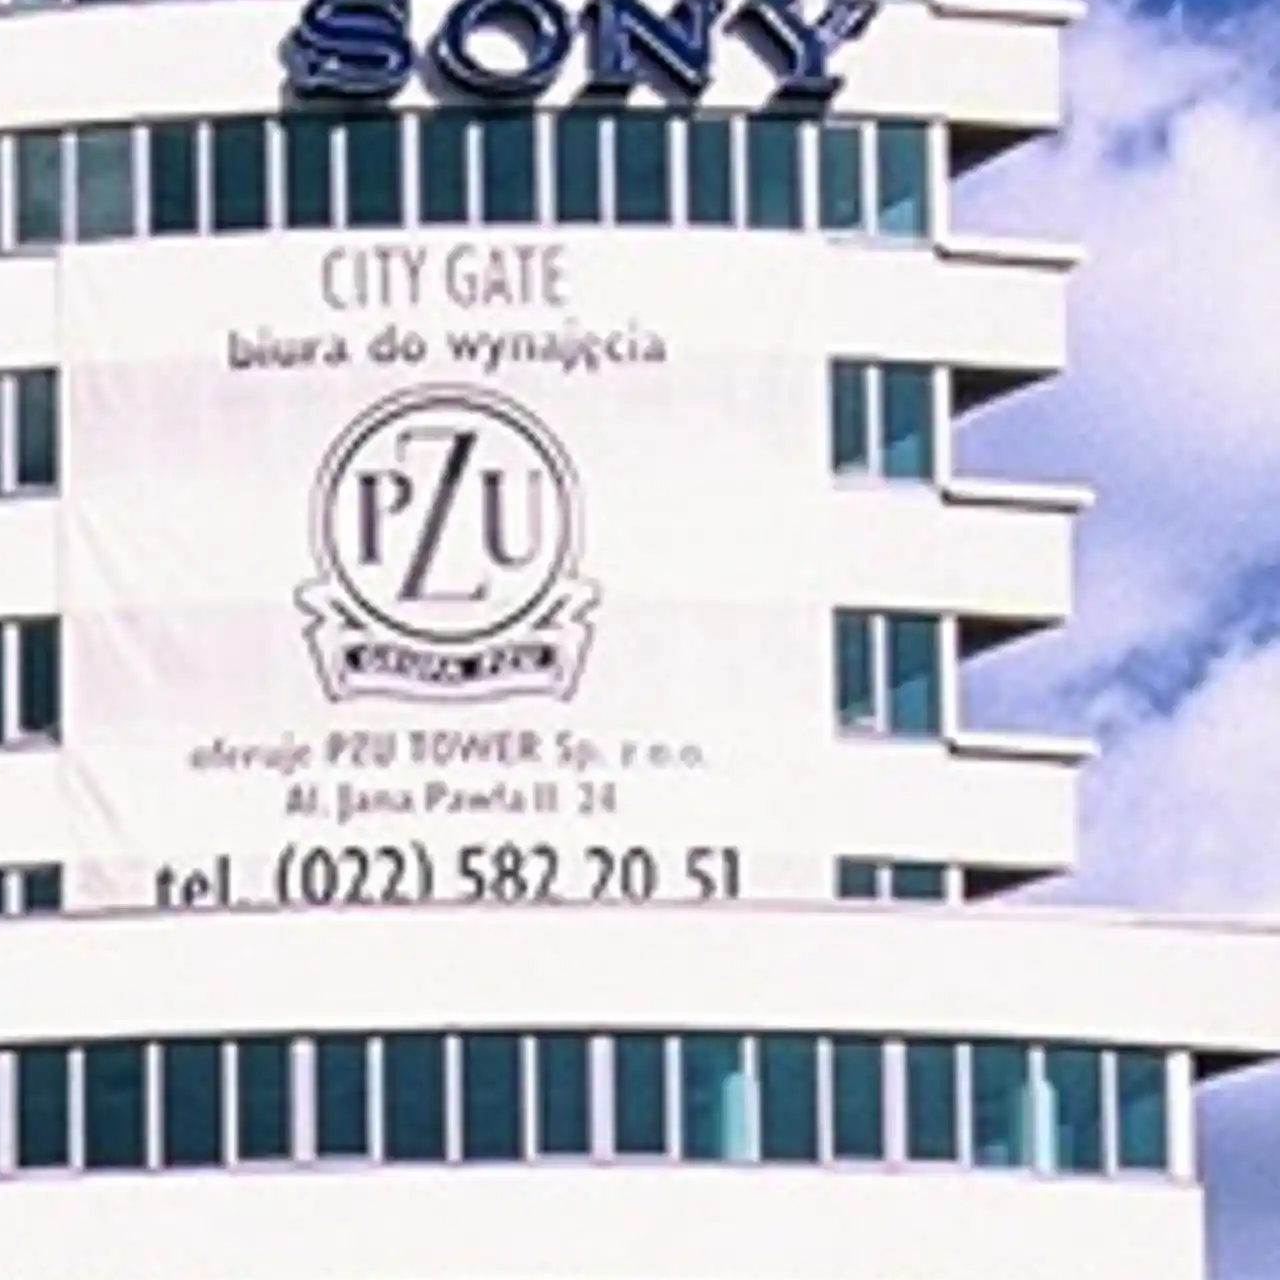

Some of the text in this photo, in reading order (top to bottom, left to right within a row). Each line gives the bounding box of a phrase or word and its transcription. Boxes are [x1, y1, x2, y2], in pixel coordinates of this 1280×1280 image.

[321, 243, 567, 309] CITY GATE
[227, 325, 349, 370] biura
[368, 325, 427, 363] do
[354, 427, 544, 603] PZU
[325, 729, 398, 768] PZU
[408, 729, 543, 767] TOWER
[336, 781, 414, 825] Jana
[276, 841, 436, 907] (022)
[458, 845, 559, 903] 582
[585, 846, 658, 903] 20
[686, 847, 740, 902] 51
